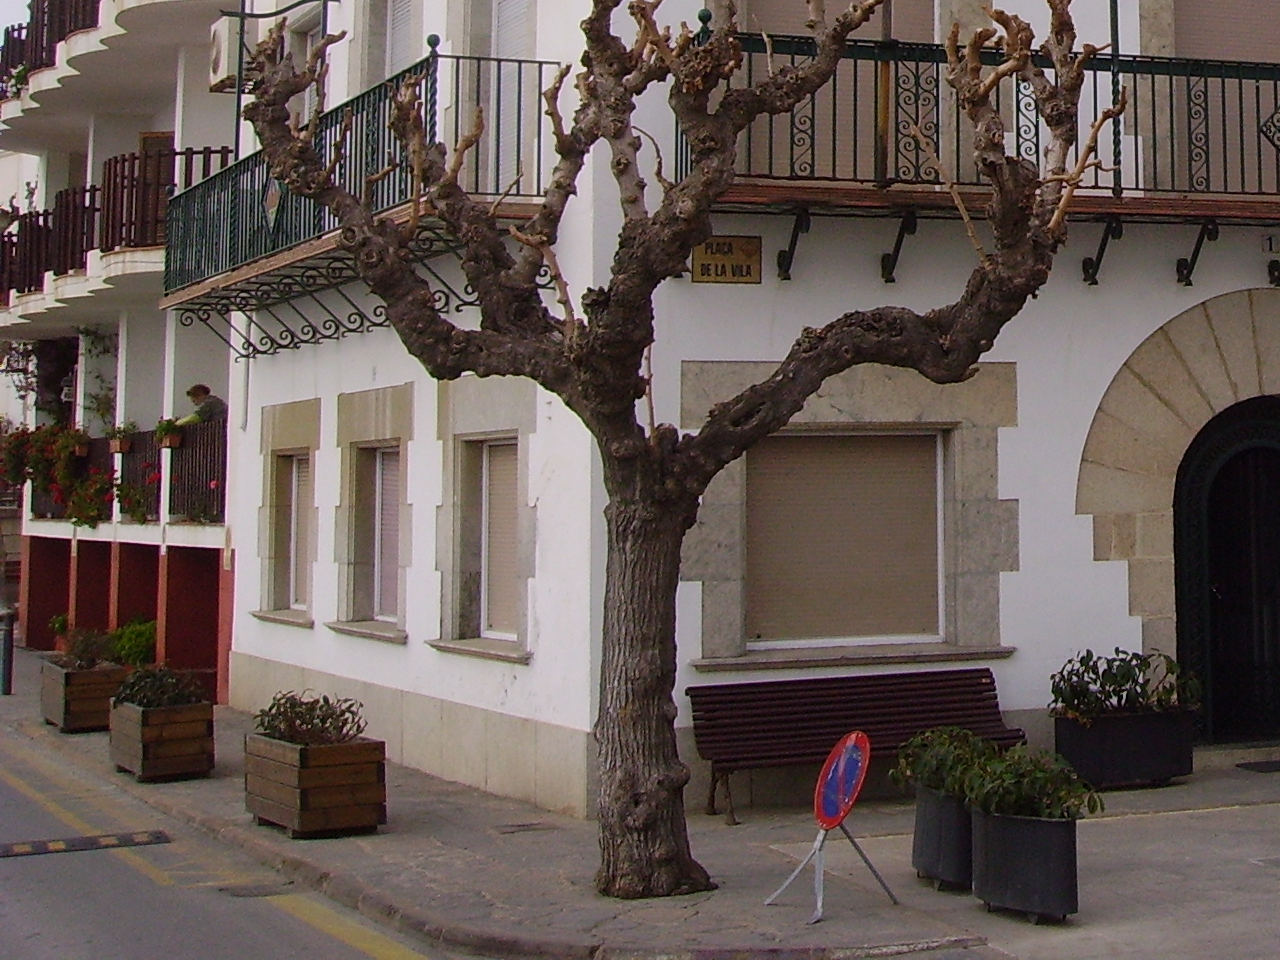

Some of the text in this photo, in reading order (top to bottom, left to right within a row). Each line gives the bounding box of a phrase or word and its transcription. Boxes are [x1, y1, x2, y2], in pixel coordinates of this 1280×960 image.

[700, 263, 752, 278] DE LA VILA
